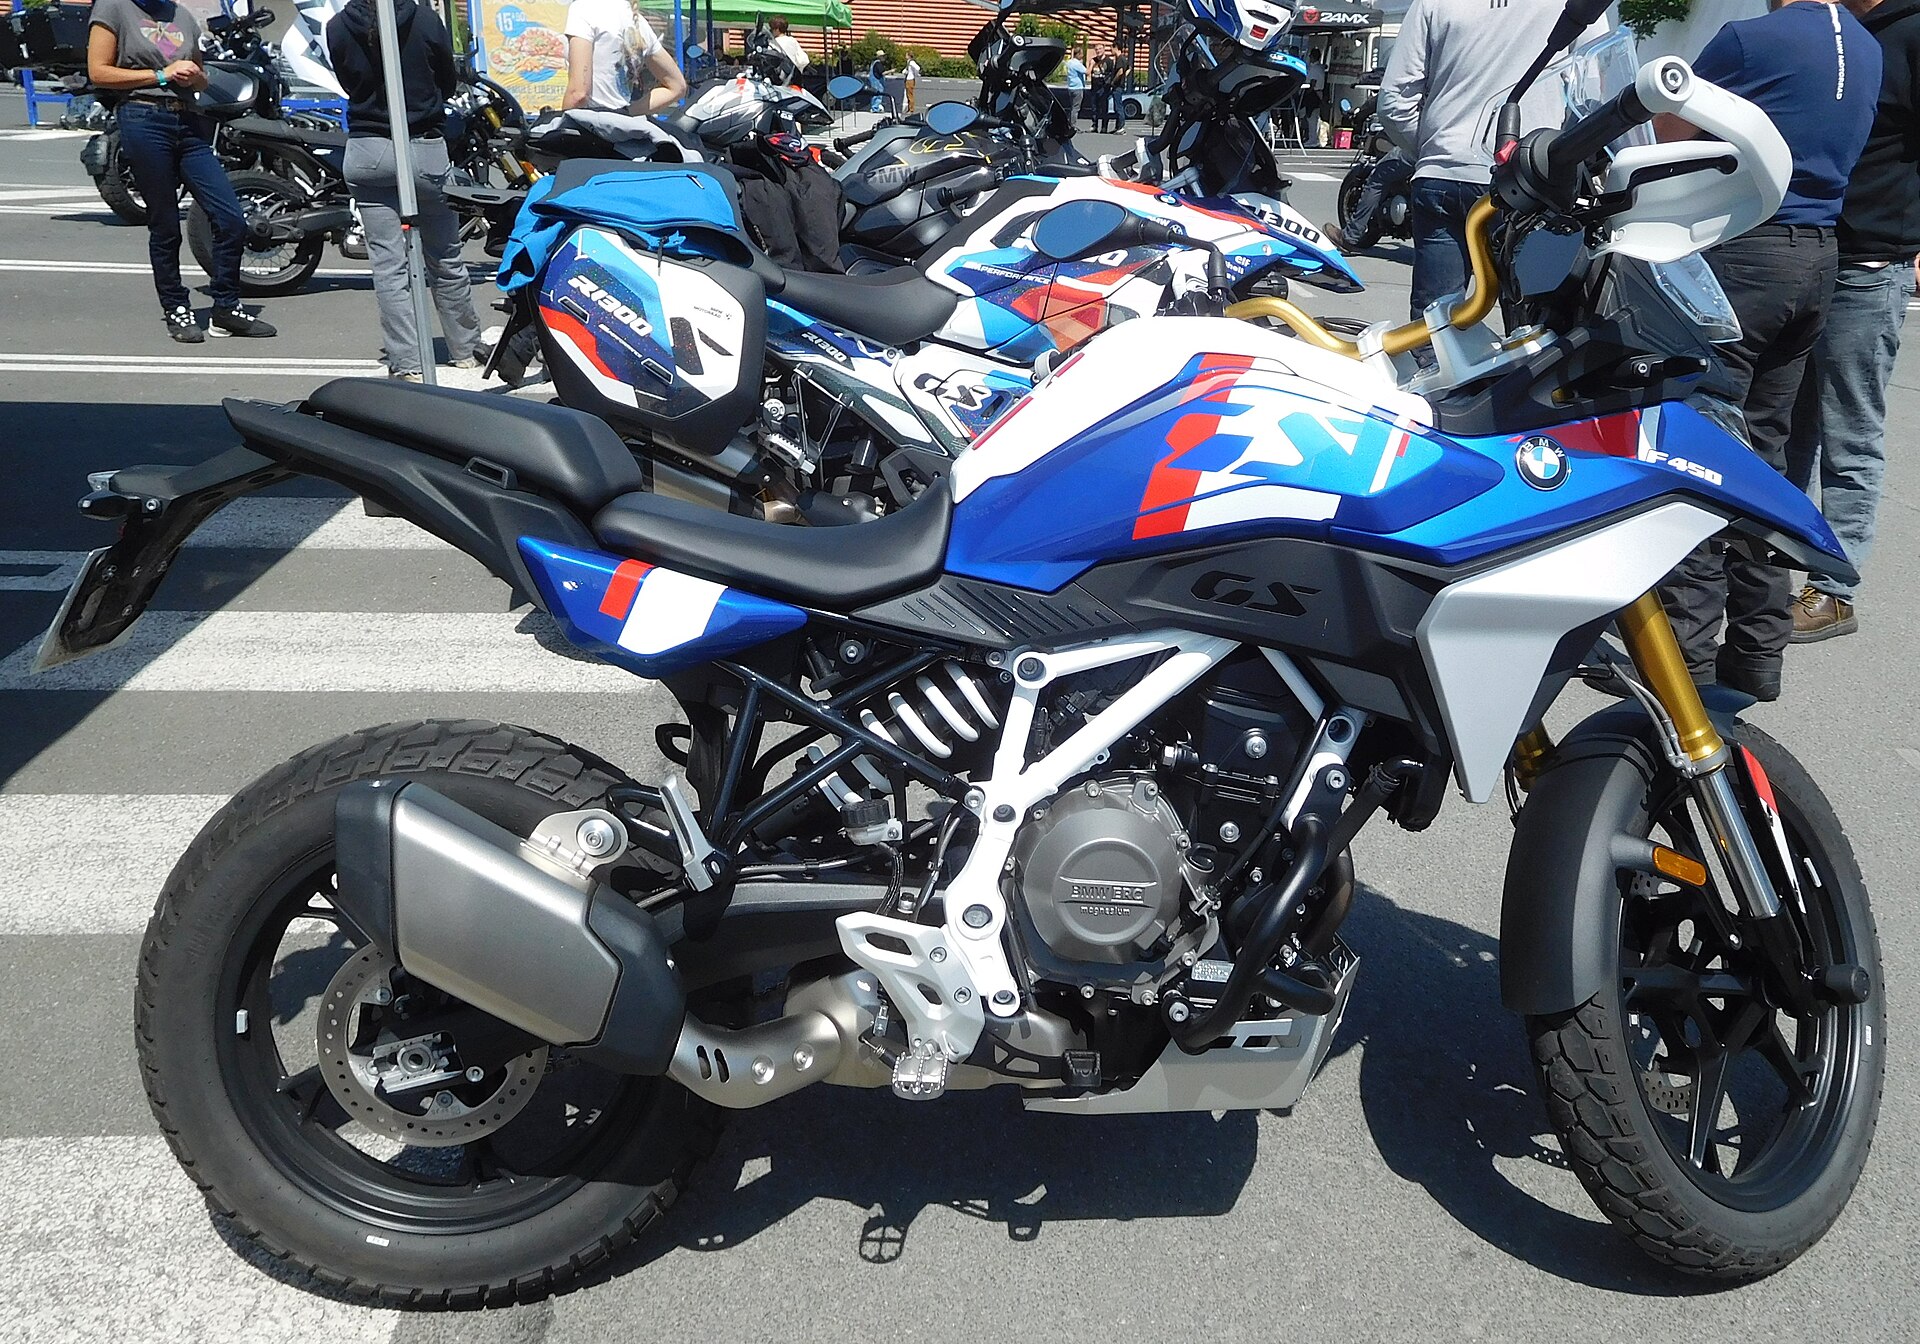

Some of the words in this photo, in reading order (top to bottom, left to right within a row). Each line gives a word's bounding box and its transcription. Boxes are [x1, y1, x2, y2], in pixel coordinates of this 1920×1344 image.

[1320, 12, 1370, 25] 24MX
[1234, 255, 1251, 267] elf
[567, 274, 653, 337] R1300
[801, 331, 847, 363] R1300
[1645, 448, 1670, 464] F
[1667, 456, 1723, 487] 450
[1190, 570, 1323, 618] GS
[1071, 885, 1110, 899] BMW
[1080, 905, 1131, 916] magnesium
